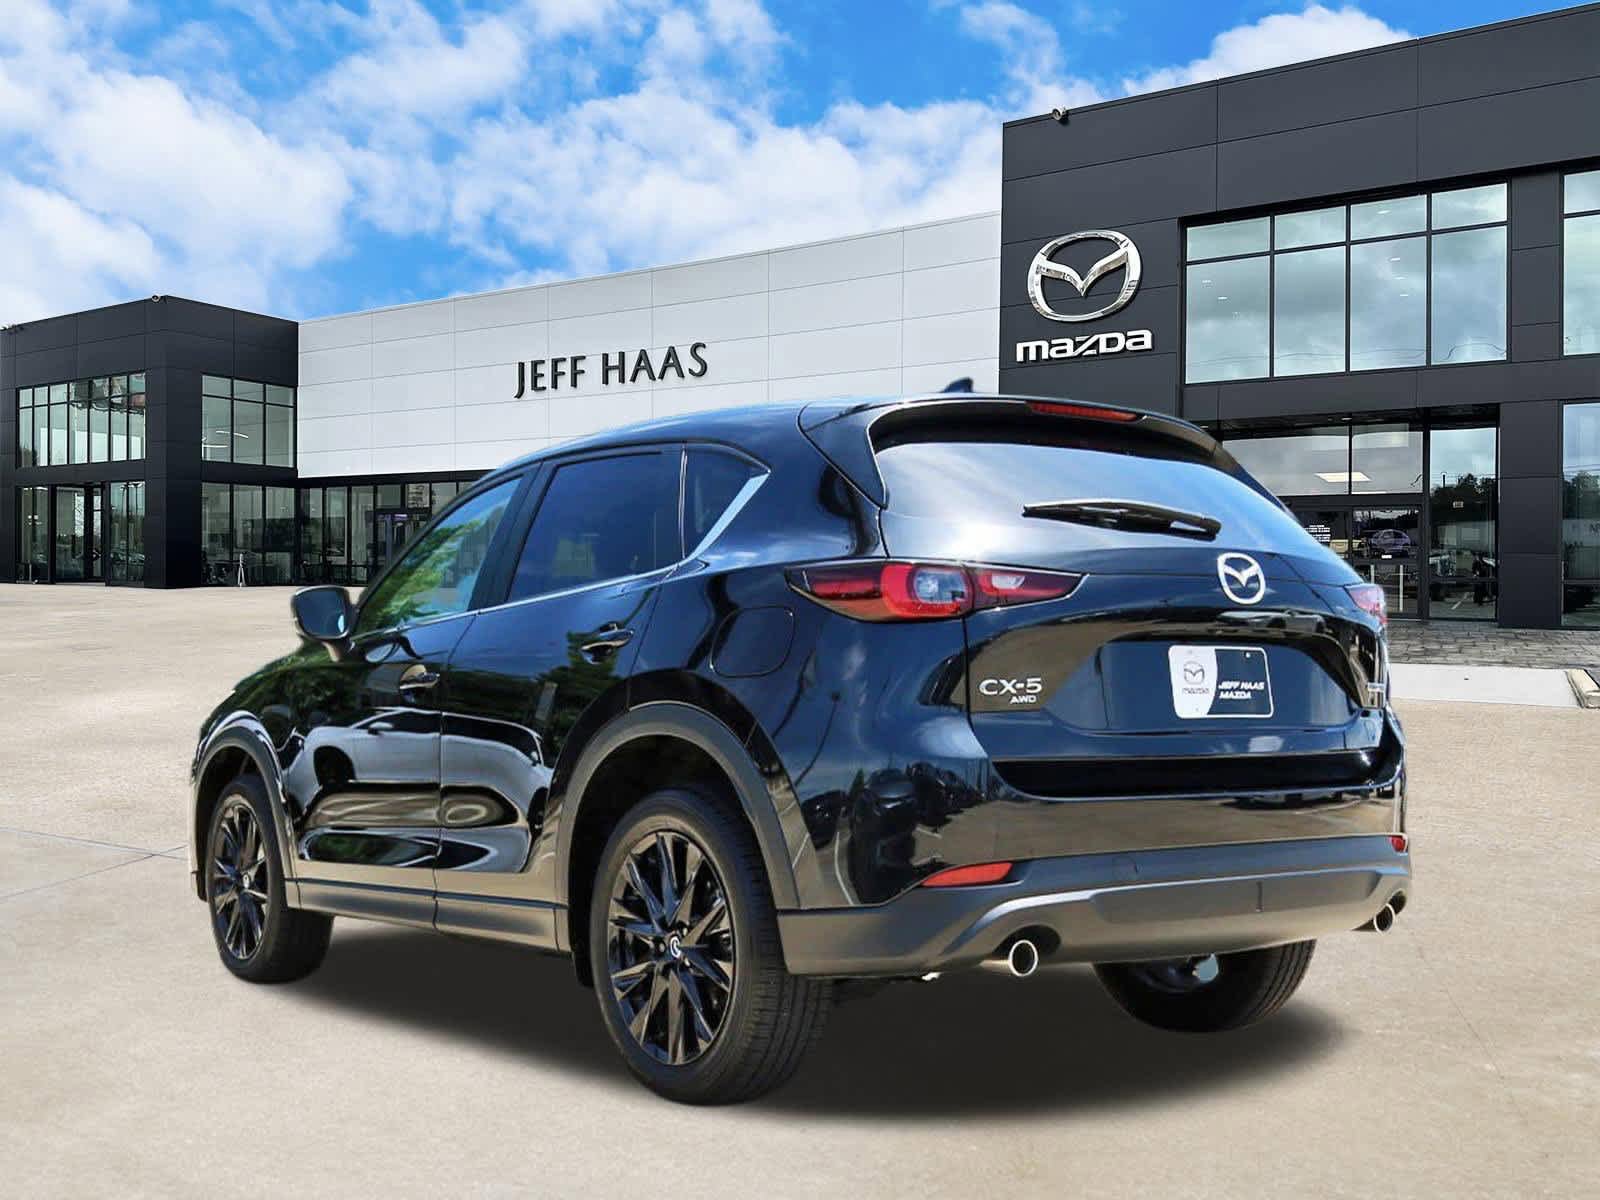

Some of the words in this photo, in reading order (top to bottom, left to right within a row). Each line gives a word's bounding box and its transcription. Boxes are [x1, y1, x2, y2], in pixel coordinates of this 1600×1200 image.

[514, 355, 587, 399] JEFF
[602, 342, 708, 385] HAAS
[979, 677, 1042, 696] CX-5
[1218, 681, 1240, 690] JEFF
[1240, 681, 1265, 691] HAAS
[1010, 695, 1037, 705] AWD
[1219, 690, 1252, 700] MAZDA
